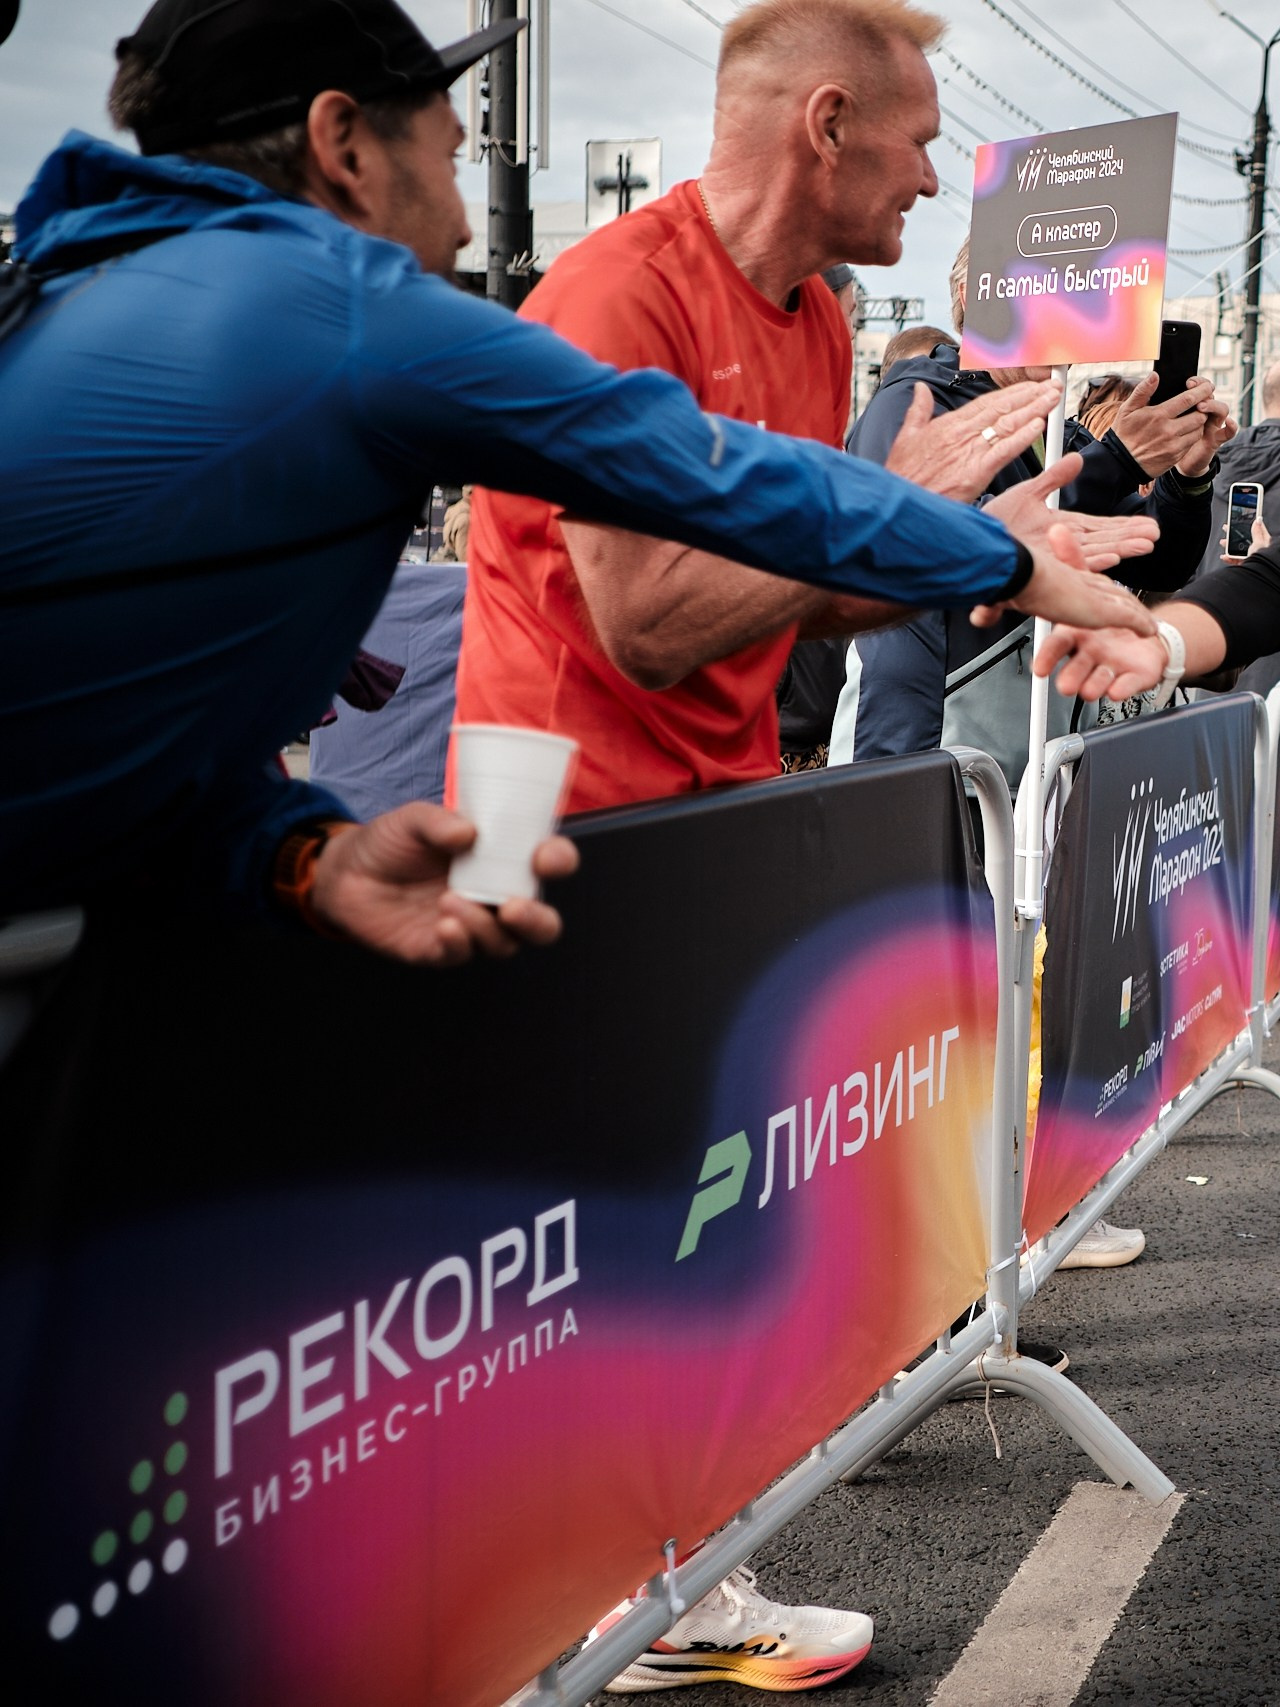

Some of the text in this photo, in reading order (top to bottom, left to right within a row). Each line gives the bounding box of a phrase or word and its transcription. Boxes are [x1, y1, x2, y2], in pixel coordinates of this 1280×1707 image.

[1046, 158, 1124, 187] Марафон 2024
[1047, 144, 1114, 169] Челябинский
[1030, 220, 1102, 245] А кластер
[977, 257, 1150, 301] Я самый быстрый
[1148, 842, 1202, 907] Марафон
[757, 1024, 960, 1211] ЛИЗИНГ
[212, 1198, 581, 1479] РЕКОРД
[215, 1308, 581, 1548] БИЗНЕС-ГРУППА
